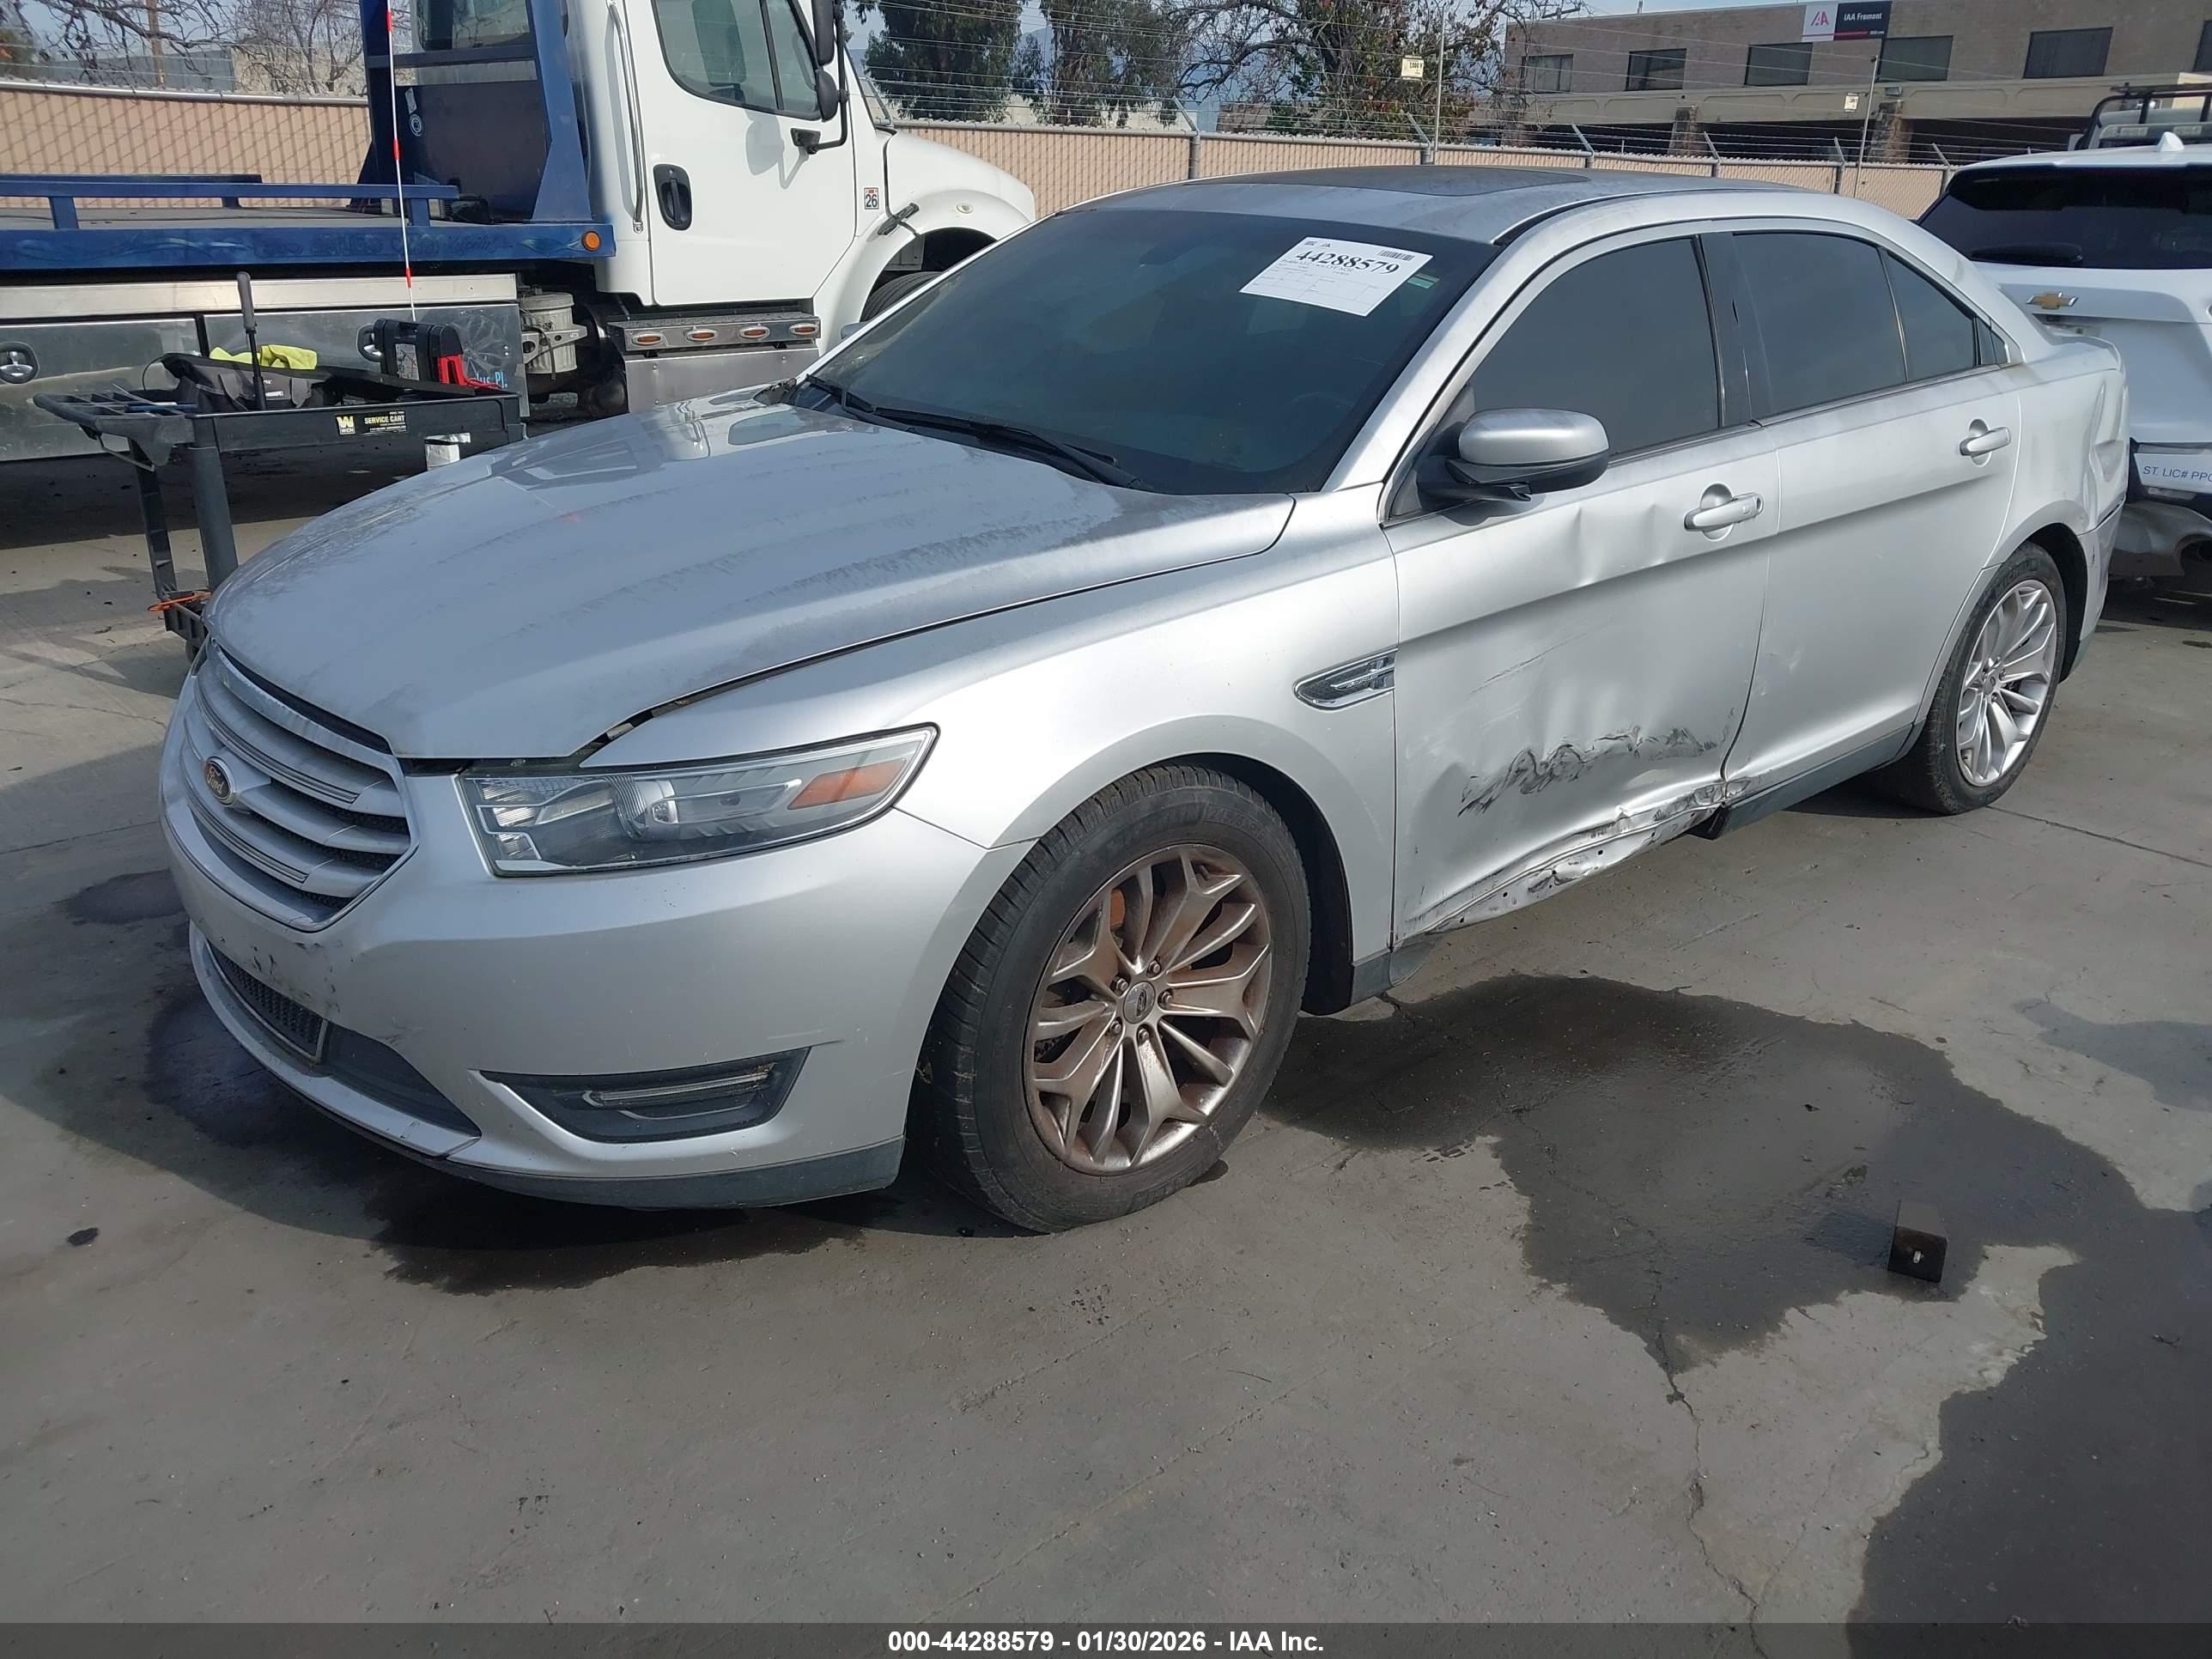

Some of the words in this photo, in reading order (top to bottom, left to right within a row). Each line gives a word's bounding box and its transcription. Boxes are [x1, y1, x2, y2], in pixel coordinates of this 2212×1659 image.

[1856, 12, 1882, 21] Fremont
[866, 193, 878, 208] 26
[1296, 250, 1401, 275] 44288579
[2142, 465, 2159, 476] ST.
[2162, 467, 2189, 479] LIC#
